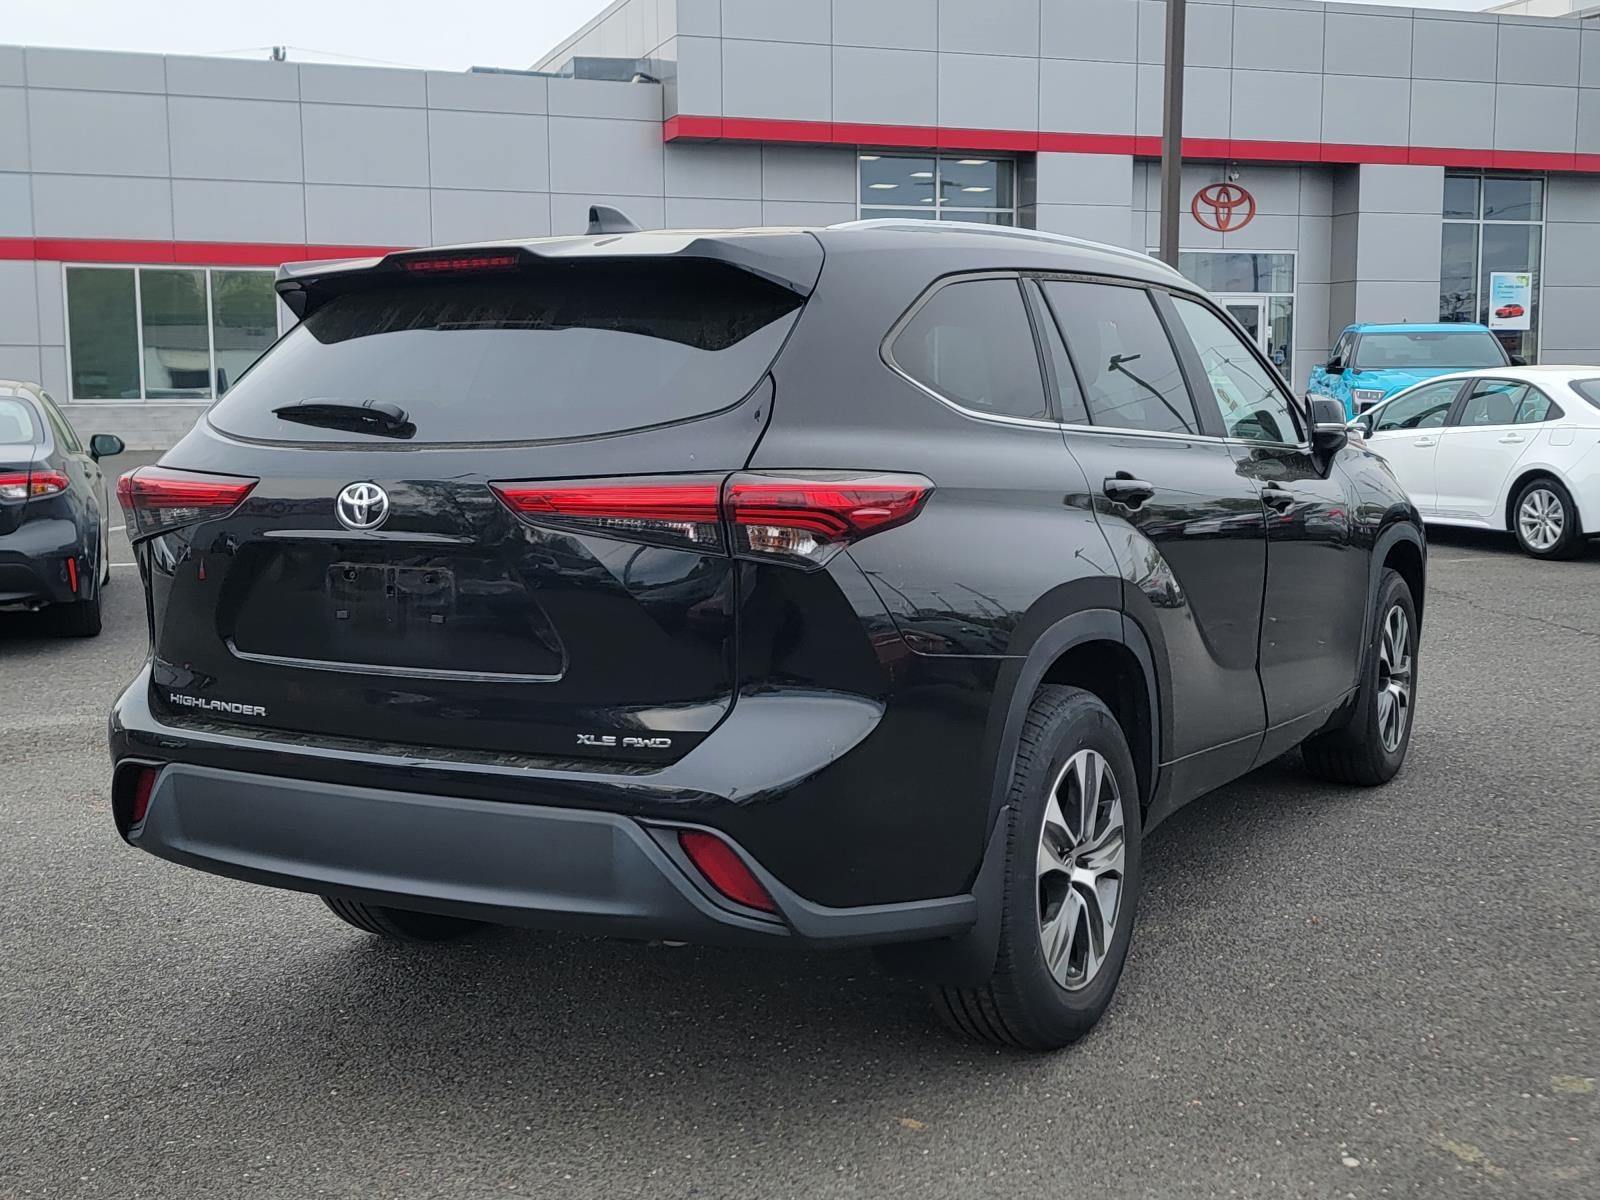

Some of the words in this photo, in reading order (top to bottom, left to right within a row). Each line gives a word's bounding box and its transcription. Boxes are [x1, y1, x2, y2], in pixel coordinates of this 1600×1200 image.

[170, 693, 266, 716] HIGHLANDER
[577, 733, 616, 746] XLE
[623, 737, 672, 748] AWD
